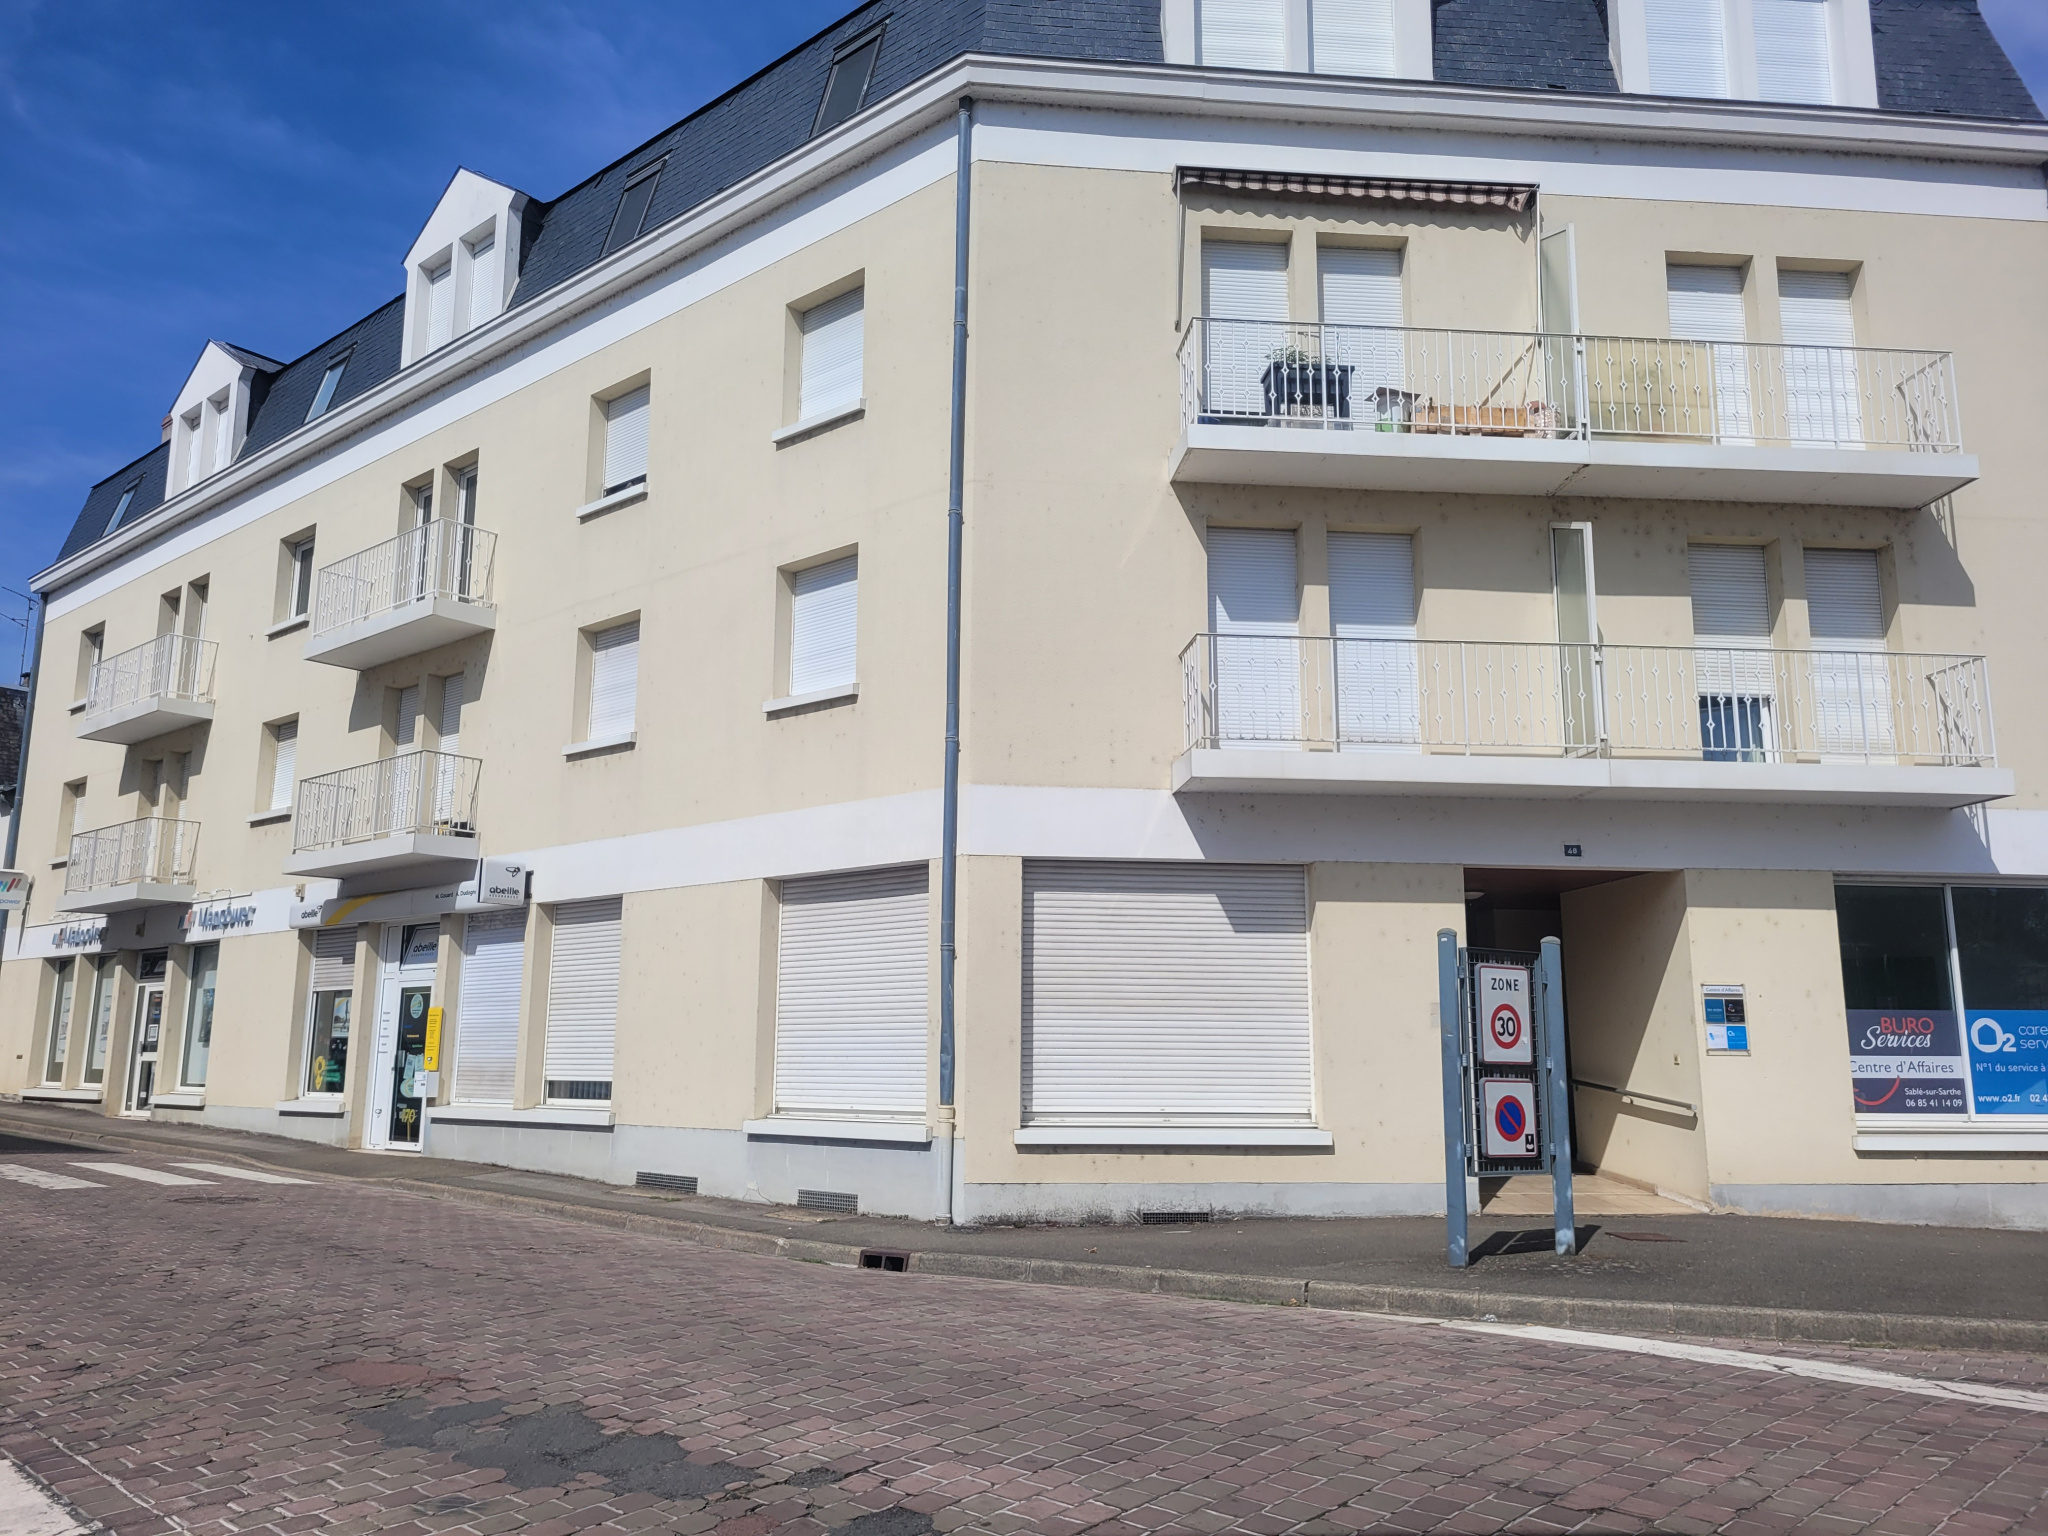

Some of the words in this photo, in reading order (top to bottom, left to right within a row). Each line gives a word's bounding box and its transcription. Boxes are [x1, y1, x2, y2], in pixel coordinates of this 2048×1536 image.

[1568, 847, 1578, 855] 48
[488, 886, 519, 896] abeille
[301, 909, 318, 919] abeille
[413, 941, 437, 952] abeille
[1491, 977, 1520, 992] ZONE
[1497, 1016, 1516, 1037] 30
[1880, 1017, 1934, 1034] BURO
[2018, 1025, 2048, 1036] care
[1860, 1025, 1931, 1050] Services
[1850, 1060, 1891, 1073] Centre
[1896, 1060, 1954, 1073] d'Affaires
[1976, 1063, 1992, 1072] N°1
[1995, 1063, 2006, 1072] du
[2008, 1063, 2039, 1072] service
[2040, 1063, 2046, 1072] à
[1904, 1087, 1962, 1096] Sablé-sur-Sarthe
[1905, 1099, 1916, 1107] 06
[1917, 1099, 1928, 1107] 85
[1929, 1099, 1939, 1107] 41
[1941, 1099, 1951, 1107] 14
[1952, 1099, 1963, 1107] 09
[1978, 1093, 2021, 1103] www.o2.fr
[2029, 1093, 2040, 1102] 02
